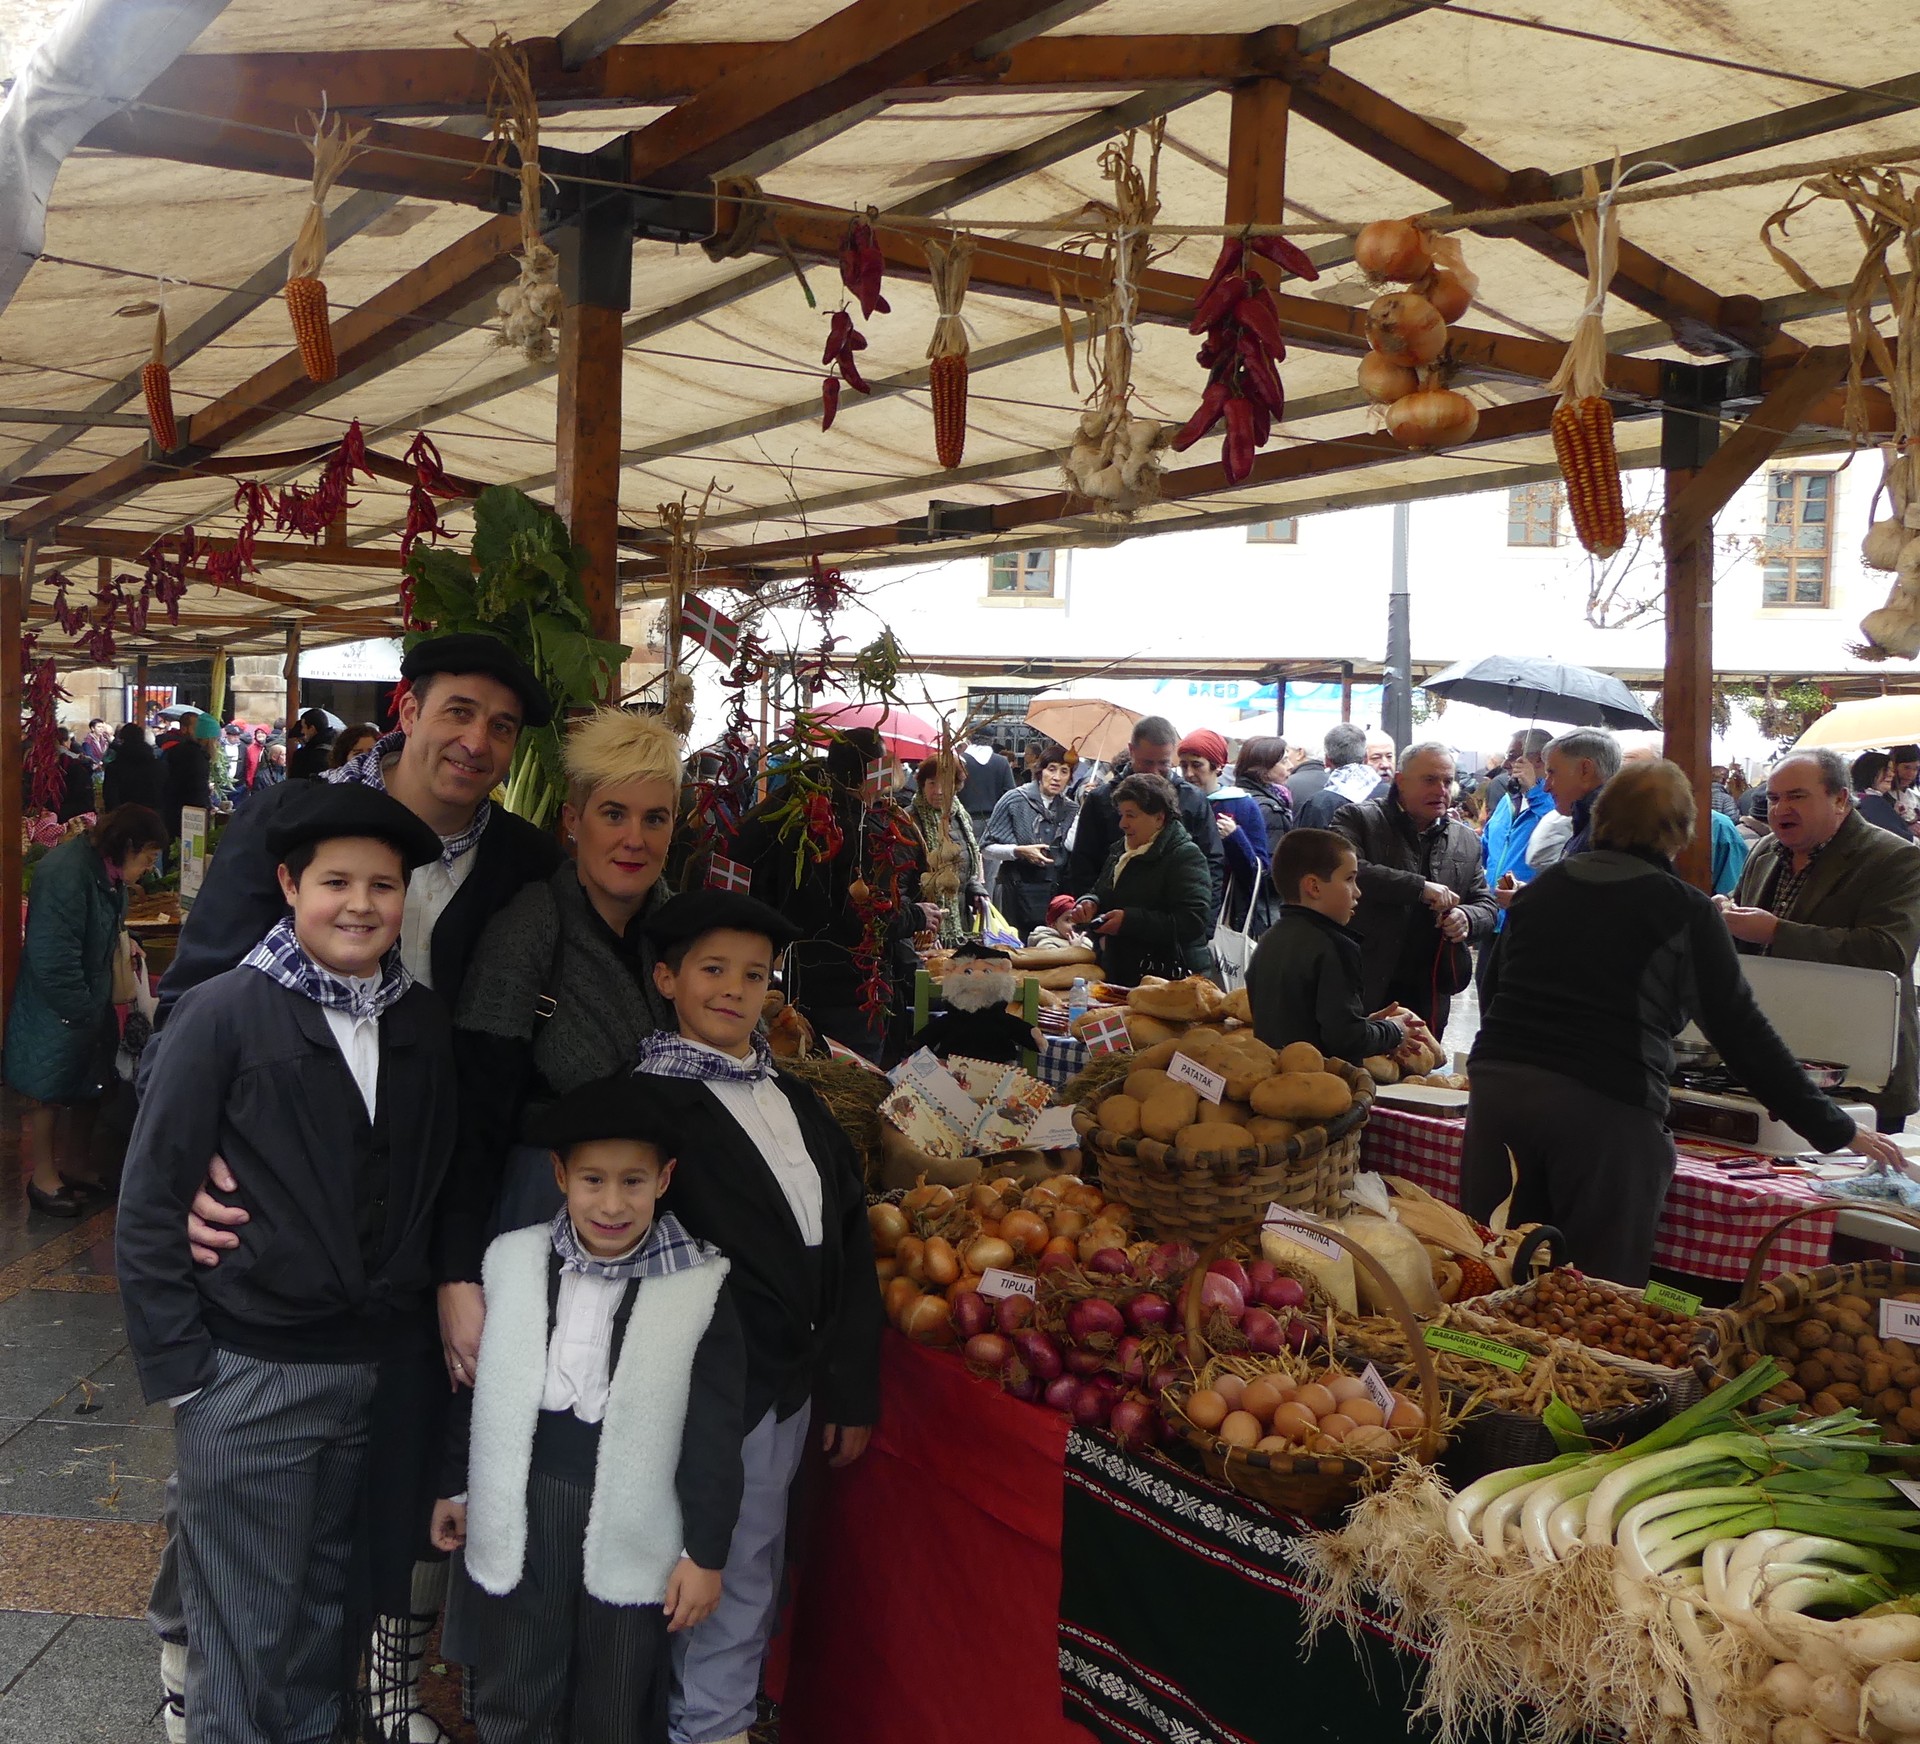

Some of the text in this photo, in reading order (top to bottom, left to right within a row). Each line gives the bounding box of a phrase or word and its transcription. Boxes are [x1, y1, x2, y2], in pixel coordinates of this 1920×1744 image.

[1180, 1064, 1213, 1088] PATATAK
[1000, 1278, 1034, 1295] TIPULA
[1658, 1289, 1688, 1304] URRAK
[1432, 1330, 1520, 1361] BABARRUN BERRIAK
